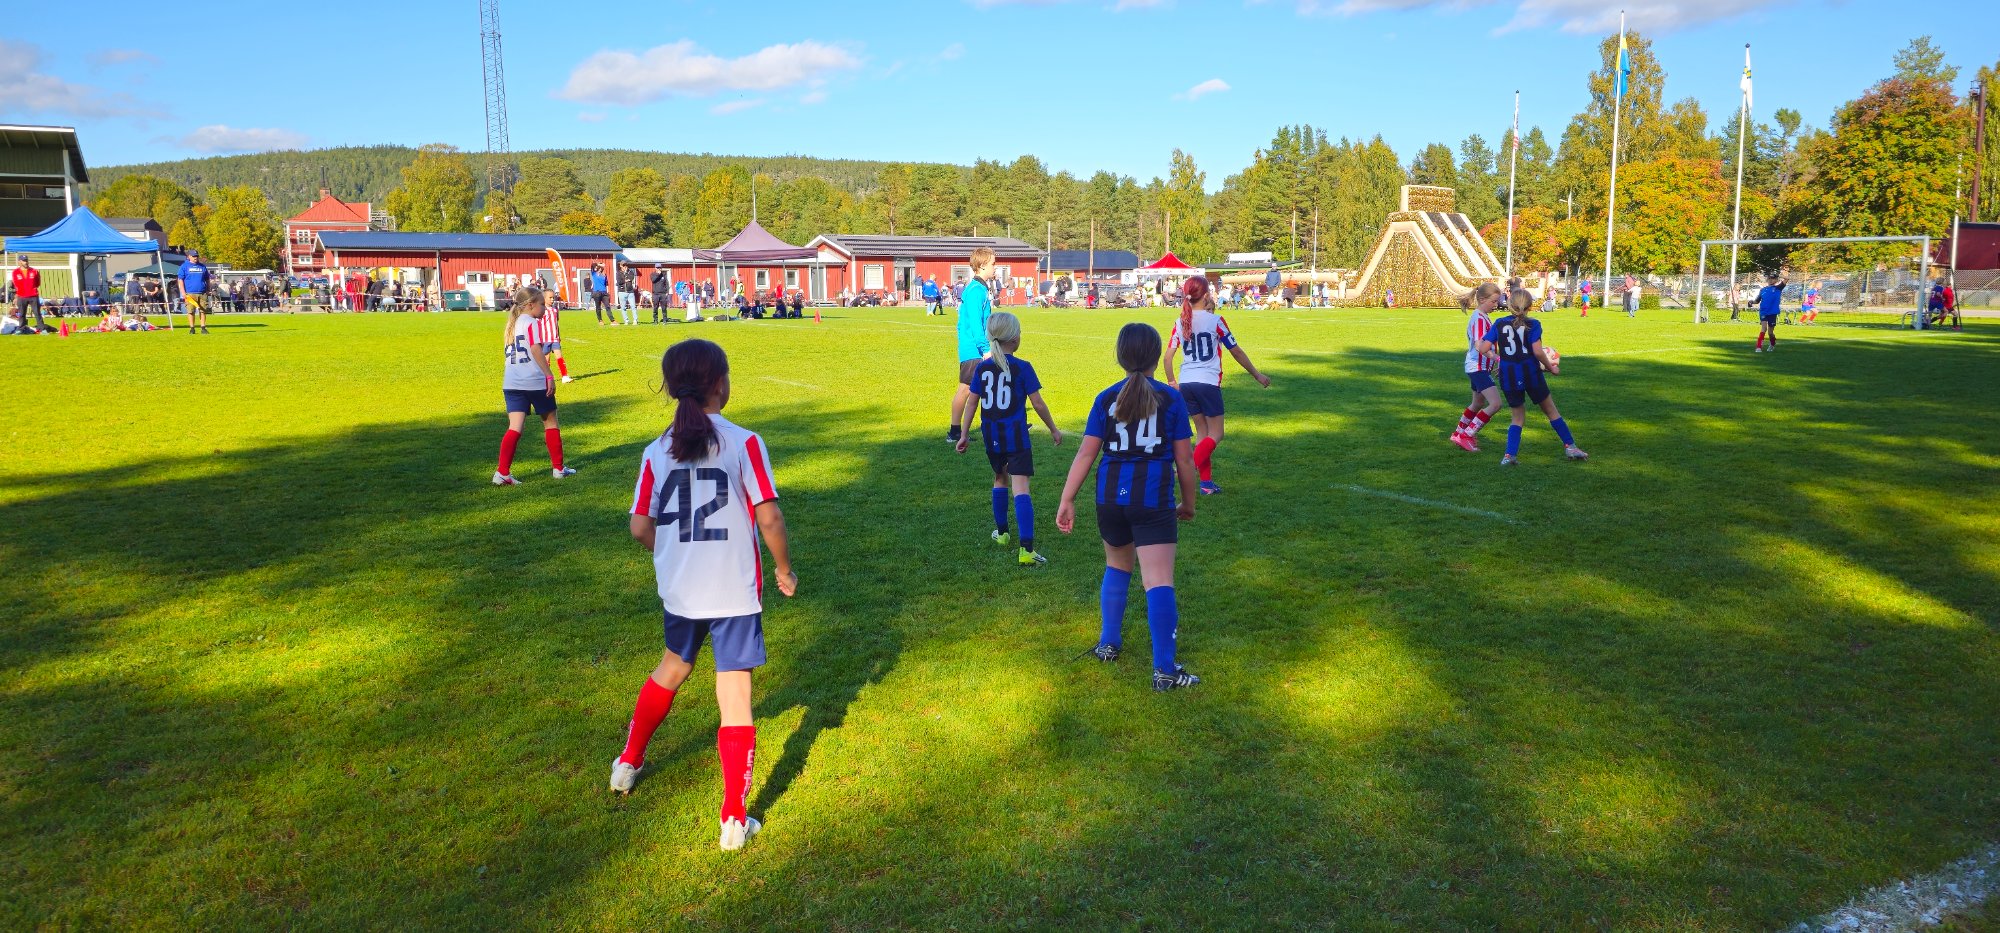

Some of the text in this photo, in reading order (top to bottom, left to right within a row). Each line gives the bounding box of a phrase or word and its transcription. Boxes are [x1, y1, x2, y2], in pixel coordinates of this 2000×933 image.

[505, 335, 531, 364] 45
[1183, 332, 1214, 362] 40
[1502, 325, 1528, 355] 31
[981, 370, 1011, 409] 36
[1108, 401, 1162, 454] 34
[657, 467, 728, 542] 42
